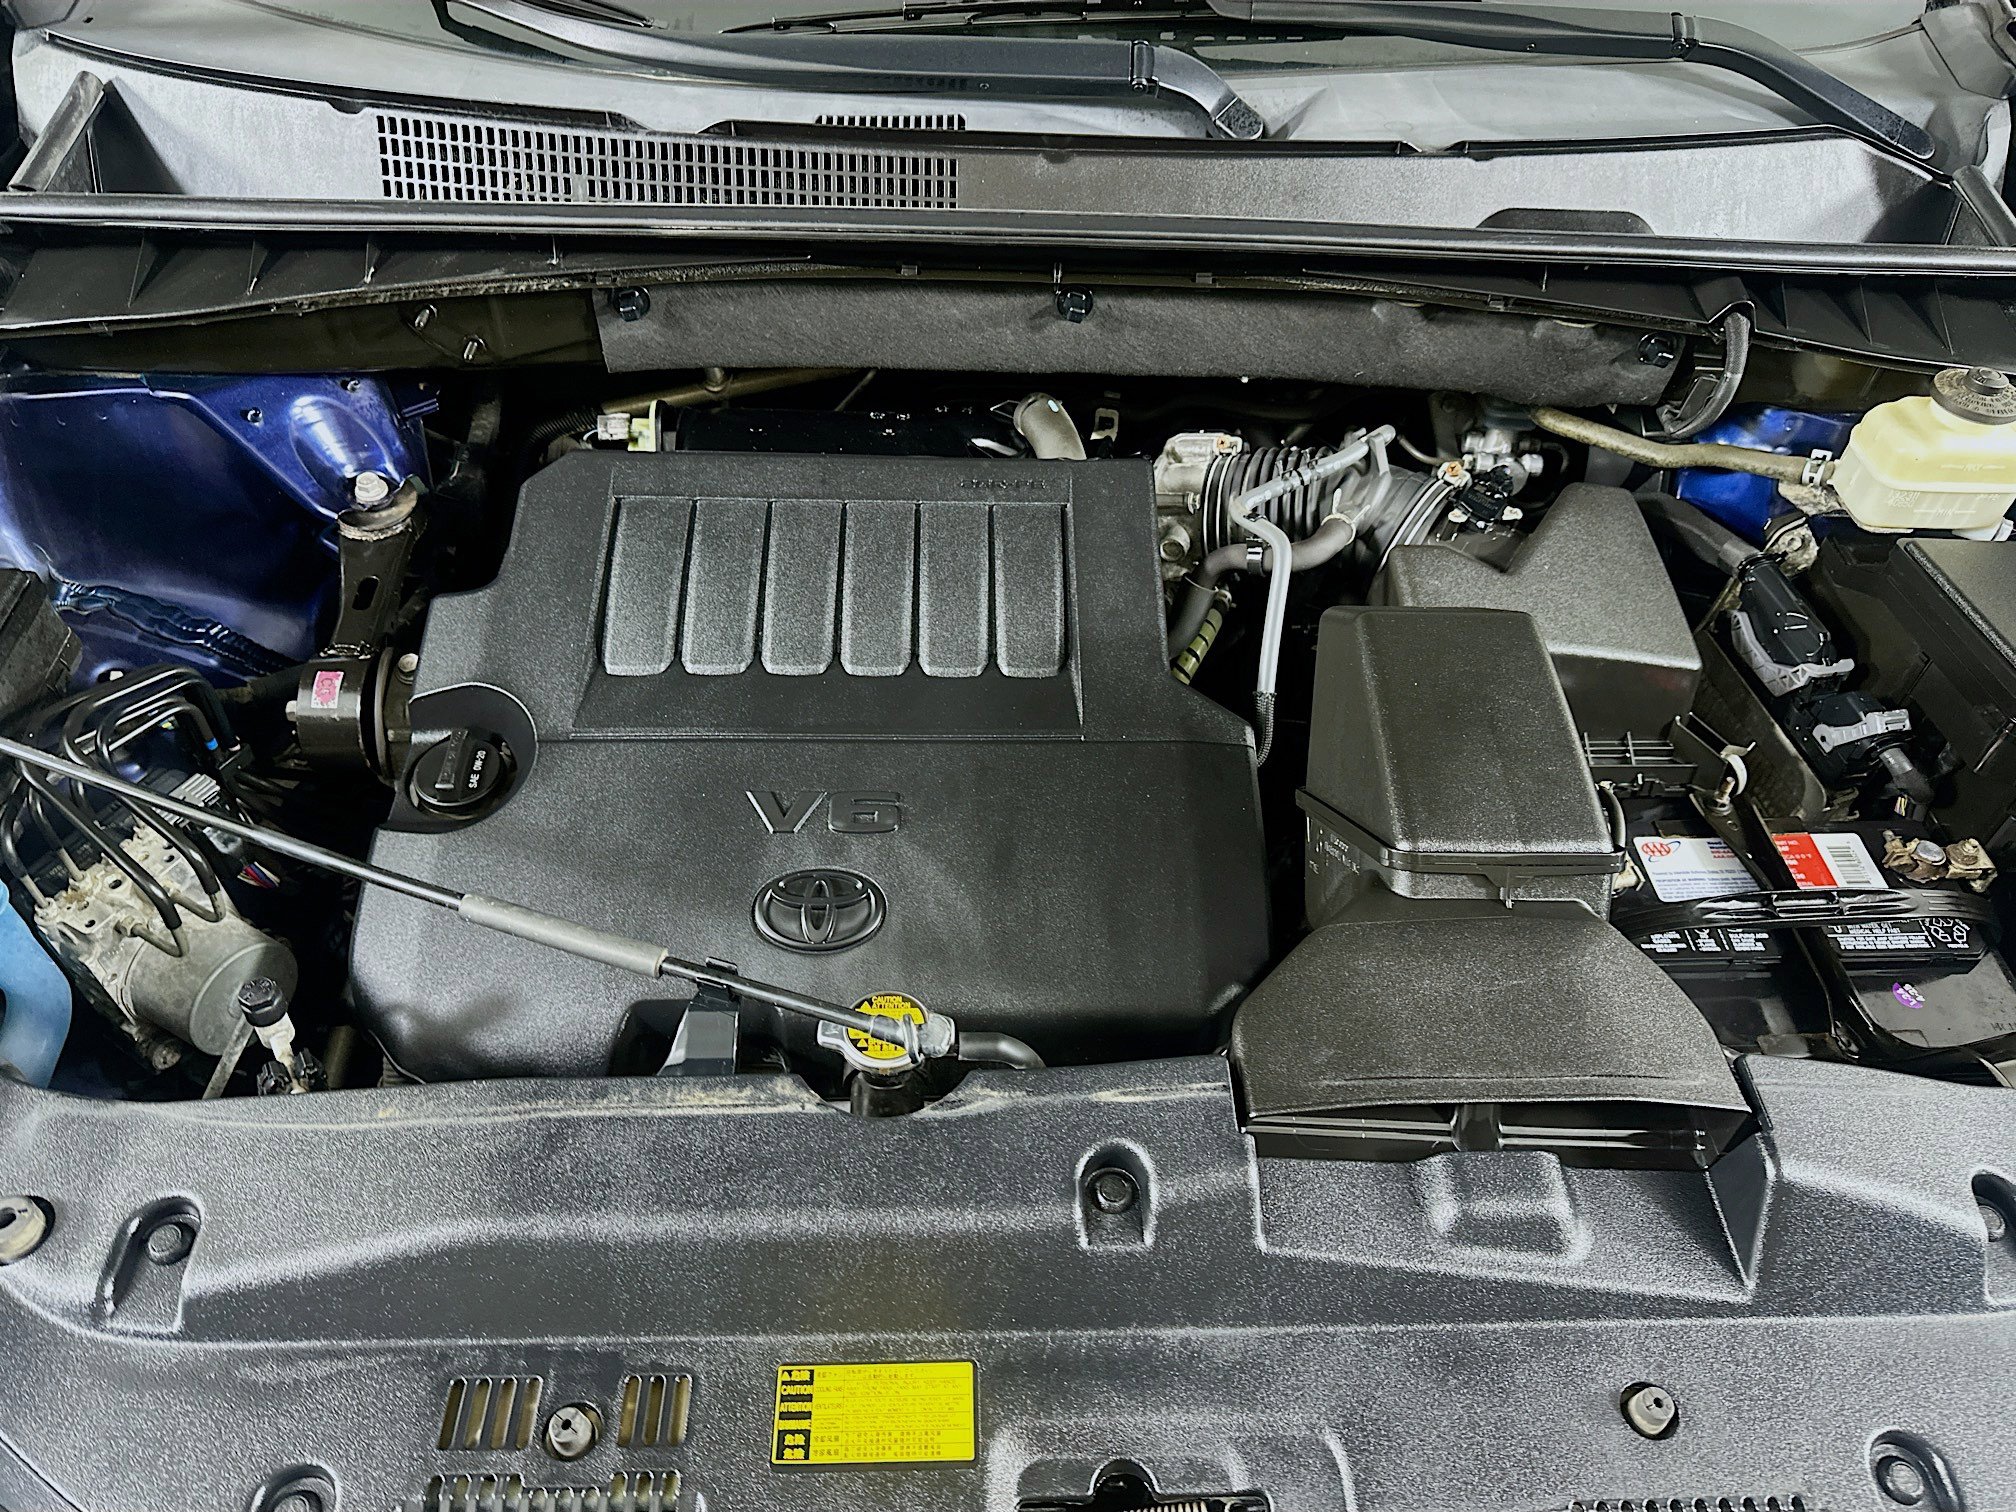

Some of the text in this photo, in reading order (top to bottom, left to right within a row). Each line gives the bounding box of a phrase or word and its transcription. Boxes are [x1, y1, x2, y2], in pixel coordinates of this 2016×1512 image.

[468, 750, 487, 788] SAE 0W-20
[745, 790, 900, 834] V6
[1642, 842, 1671, 857] AAA
[872, 995, 903, 1003] CAUTION
[871, 1001, 911, 1009] ATTENTION
[781, 1385, 813, 1395] CAUTION
[780, 1402, 812, 1412] ATTENTION
